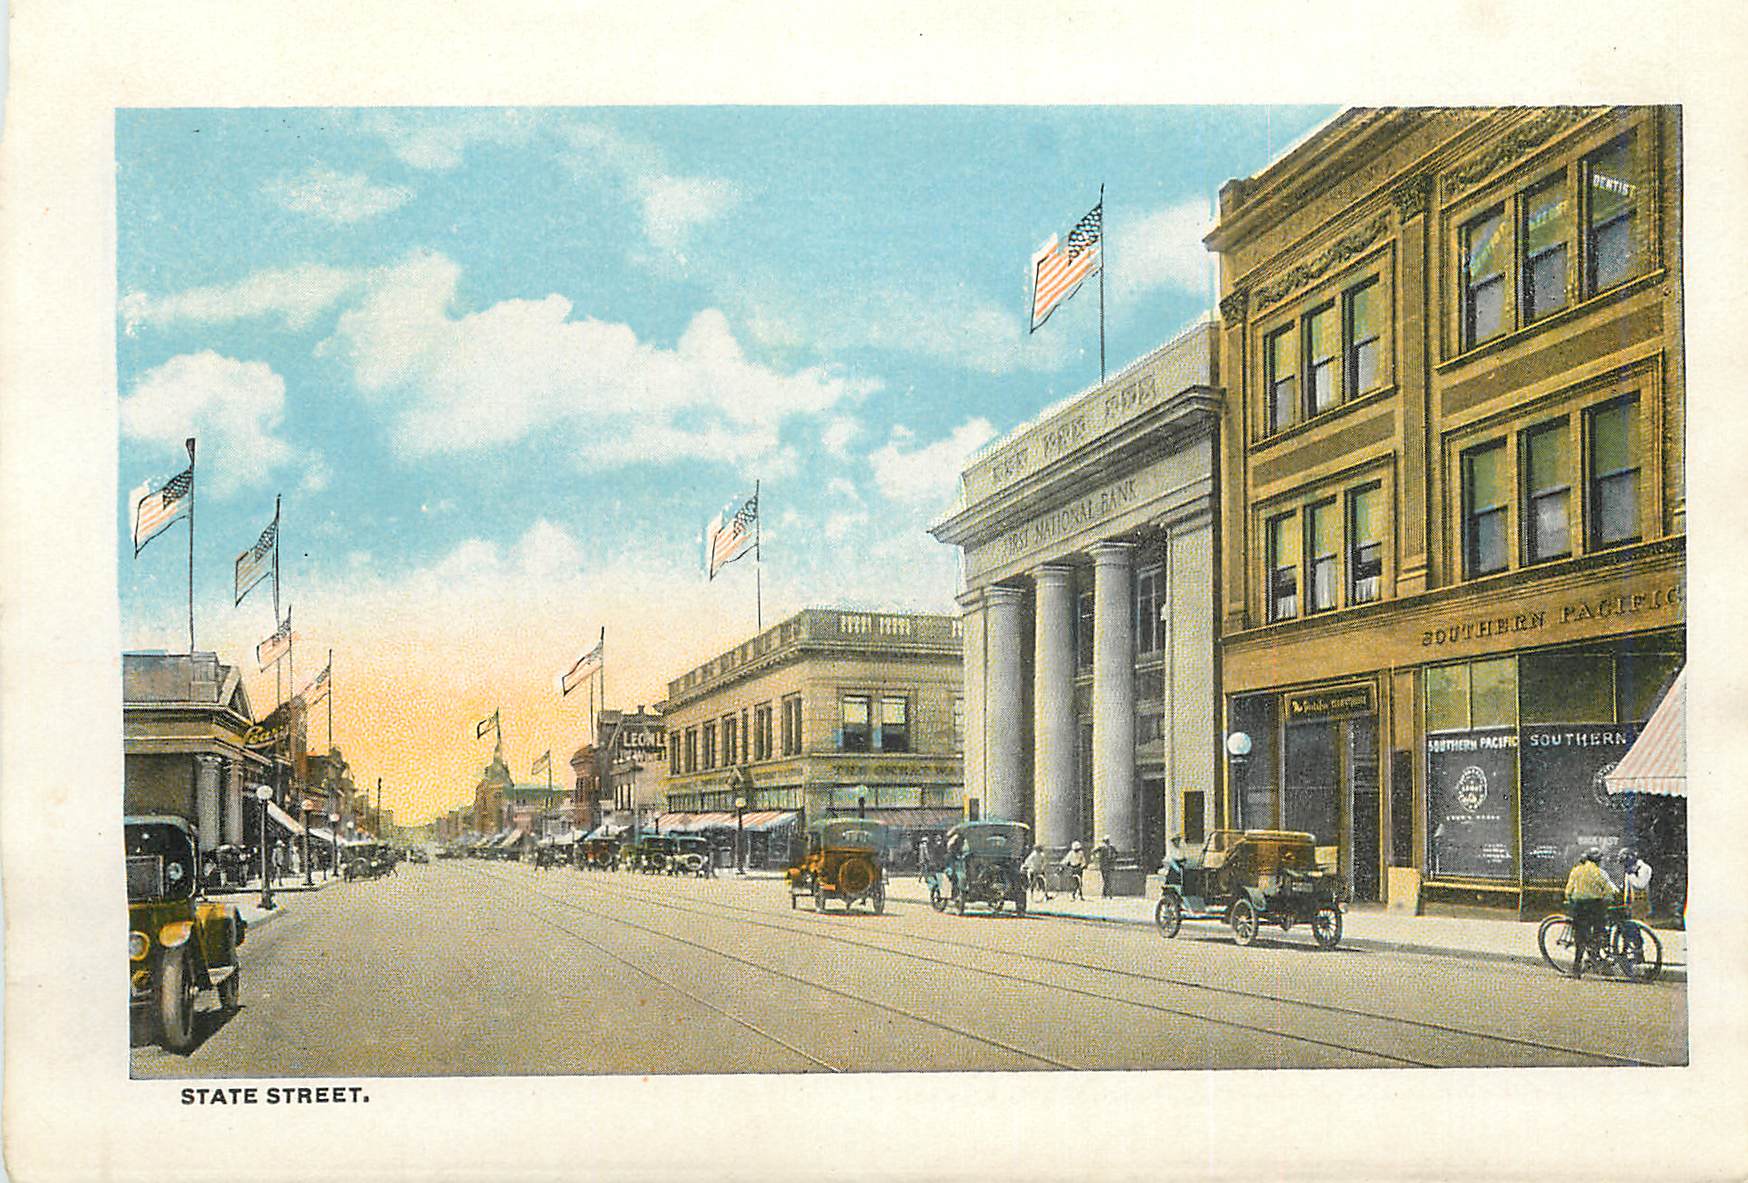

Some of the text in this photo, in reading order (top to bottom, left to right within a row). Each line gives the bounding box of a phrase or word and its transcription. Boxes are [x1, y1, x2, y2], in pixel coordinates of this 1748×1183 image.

[1592, 174, 1636, 197] DENTIST
[1035, 499, 1095, 544] NATIONAL
[1101, 479, 1137, 513] BANK
[1421, 587, 1680, 647] SOUTHERN PACIFIC
[1428, 732, 1627, 753] SOUTHERN PACIFIC SOUTHERN
